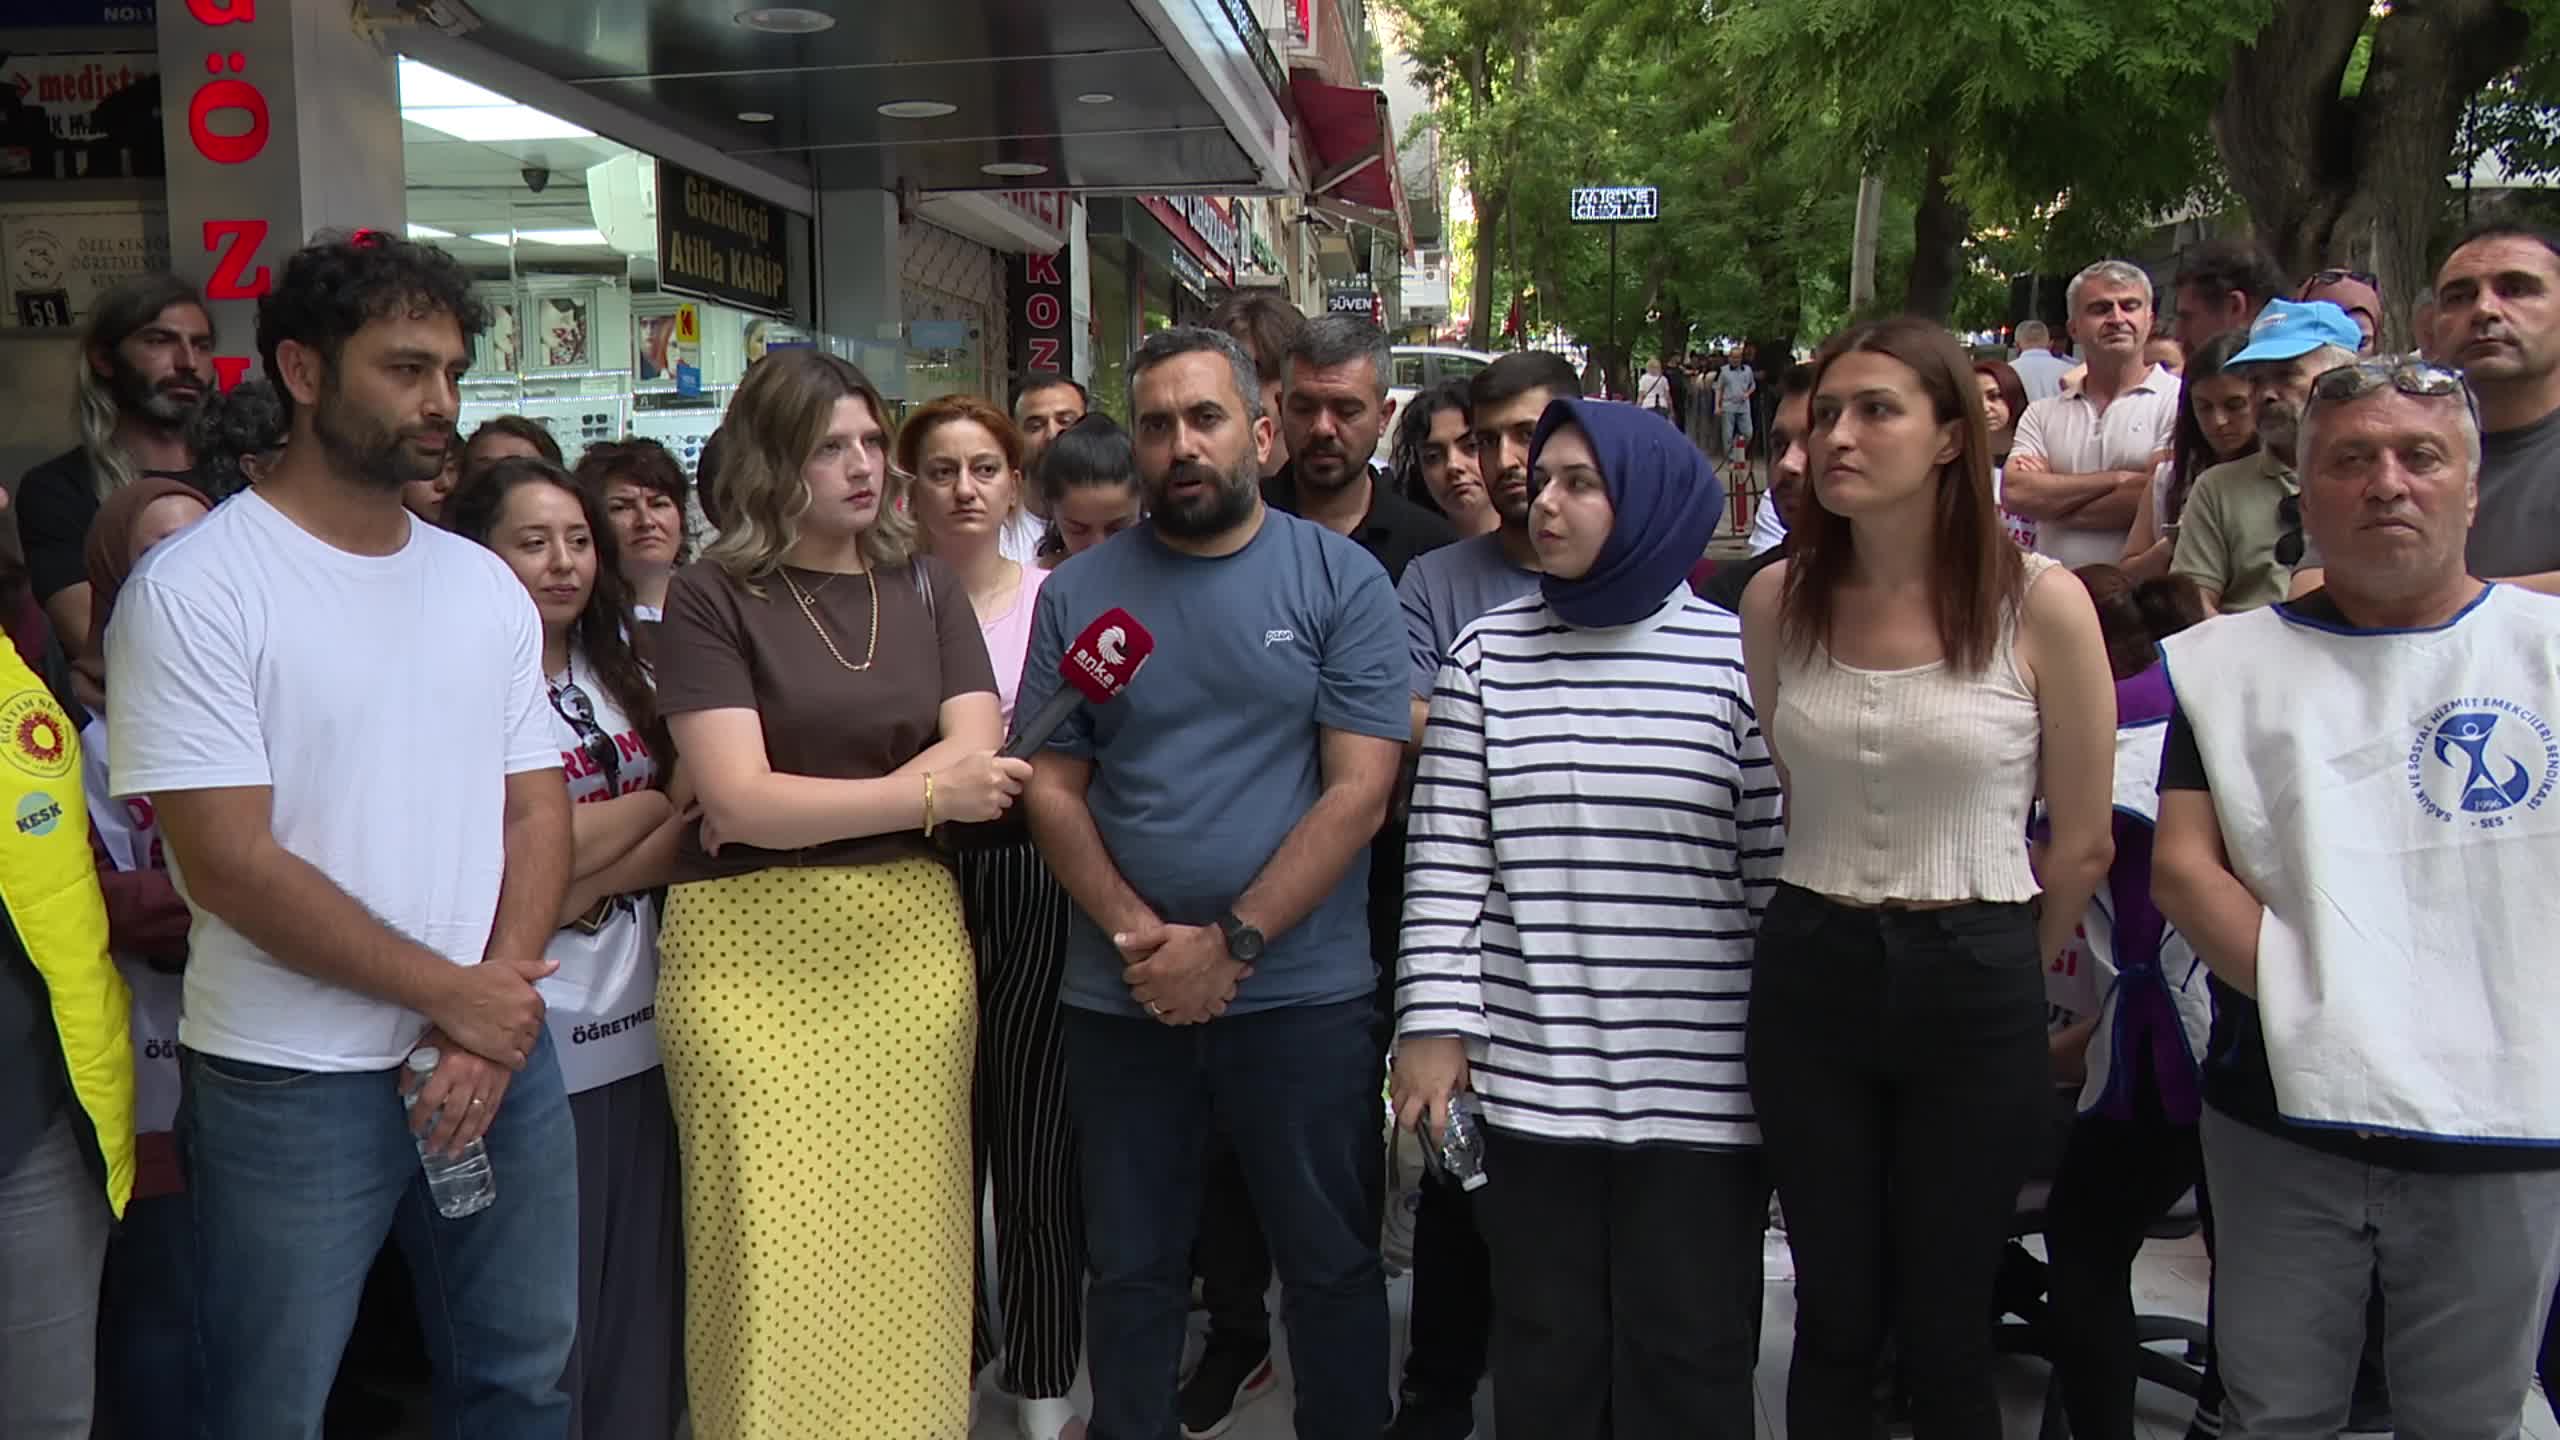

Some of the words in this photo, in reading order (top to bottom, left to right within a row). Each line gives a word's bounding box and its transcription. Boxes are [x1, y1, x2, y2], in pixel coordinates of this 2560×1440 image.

[686, 175, 769, 248] Gözlükçü
[670, 229, 724, 284] Atilla
[1076, 648, 1115, 686] anka
[16, 802, 63, 833] KESK
[2480, 816, 2504, 829] SES
